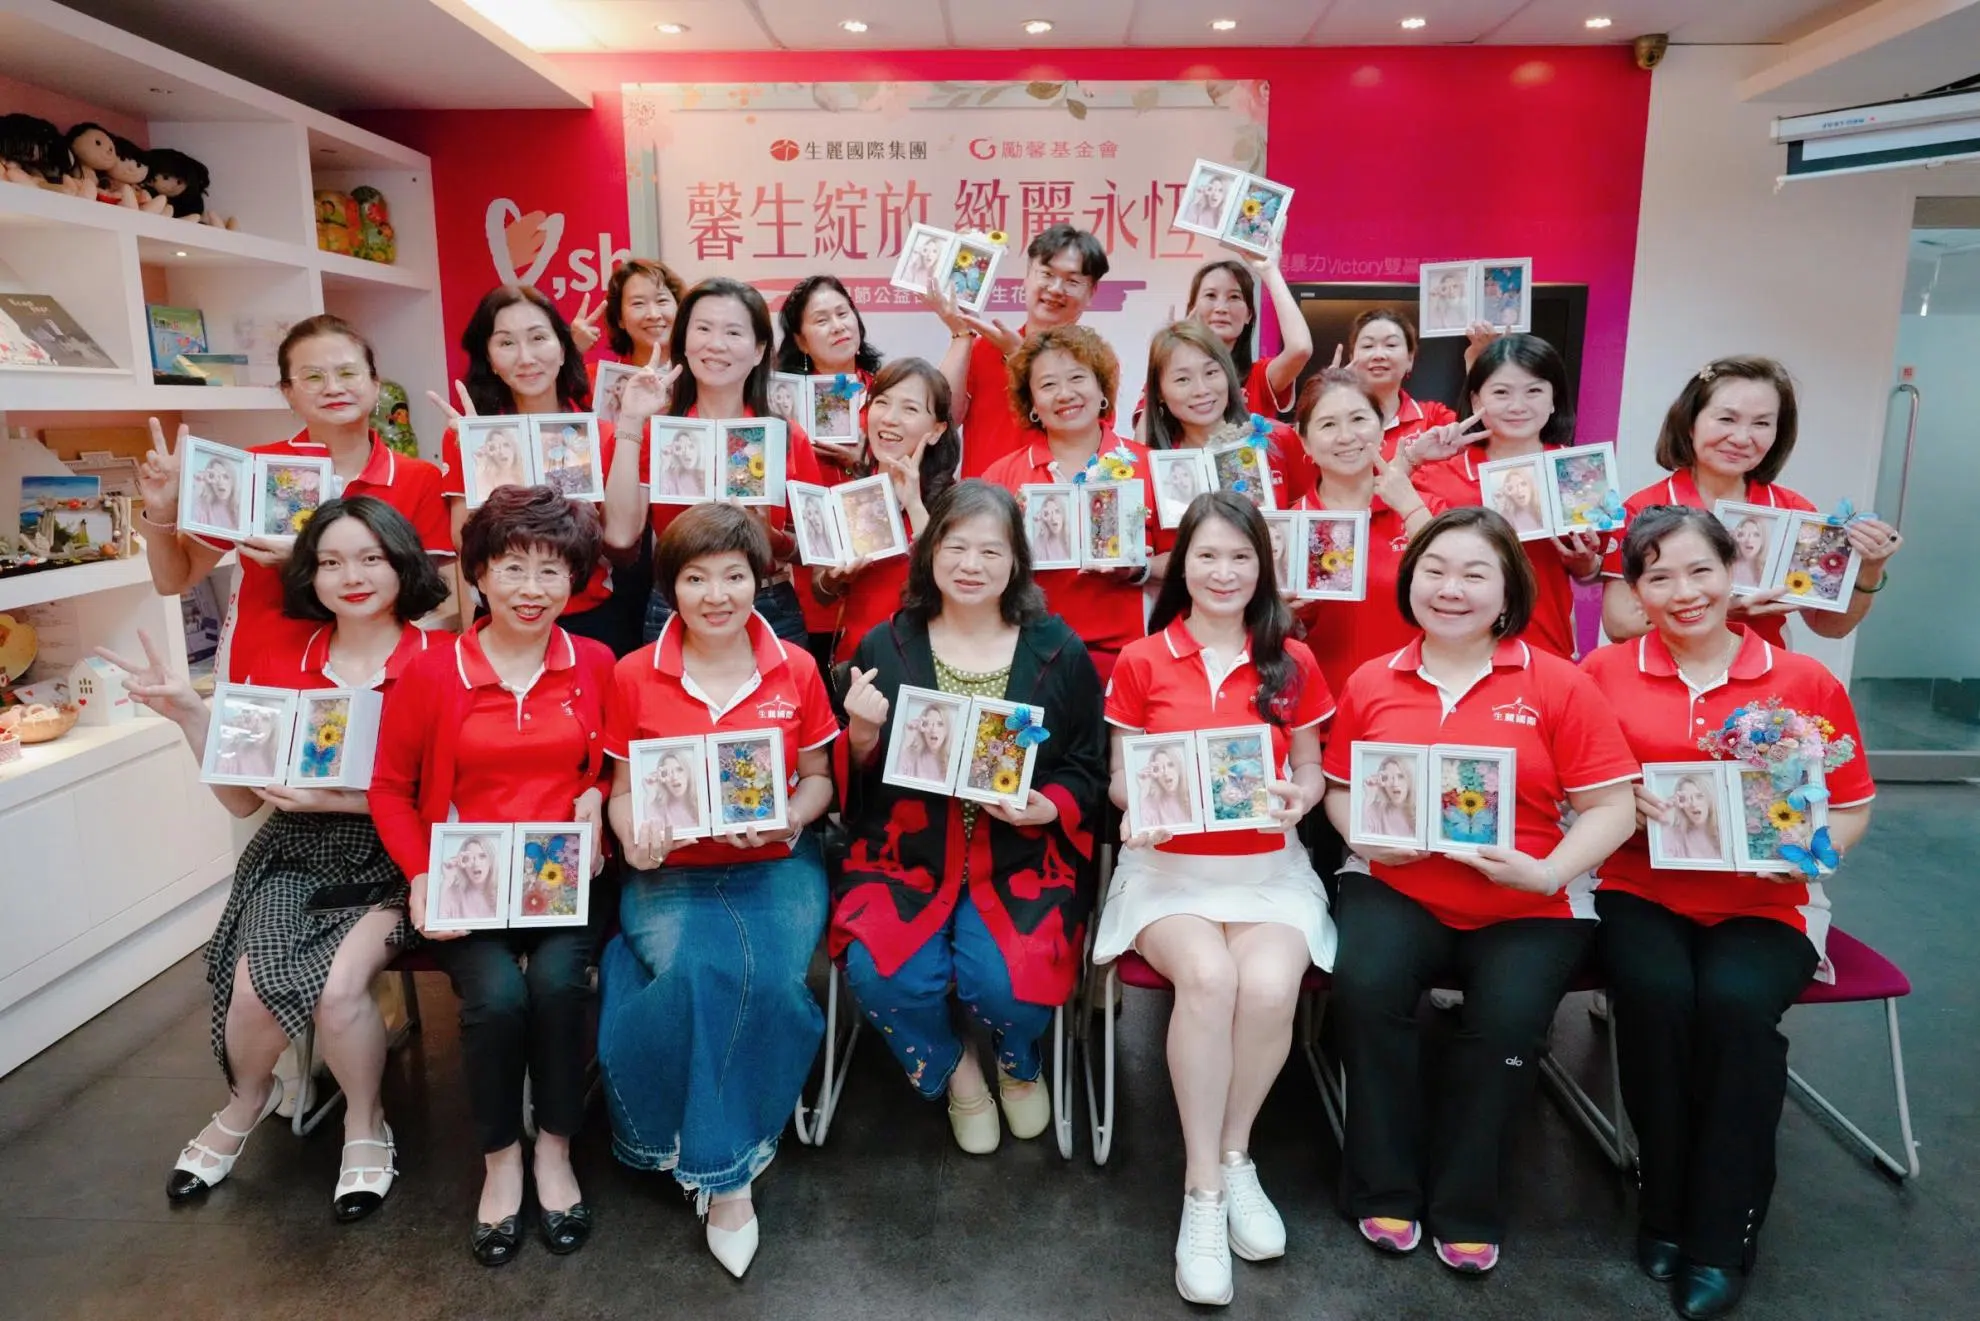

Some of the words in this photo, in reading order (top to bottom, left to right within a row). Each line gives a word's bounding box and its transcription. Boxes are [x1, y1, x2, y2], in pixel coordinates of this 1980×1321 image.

[804, 141, 927, 160] 生麗國際集團
[1001, 140, 1119, 159] 勵馨基金會
[686, 179, 932, 261] 馨生綻放
[846, 284, 924, 305] 節公益
[1505, 1055, 1523, 1067] alo
